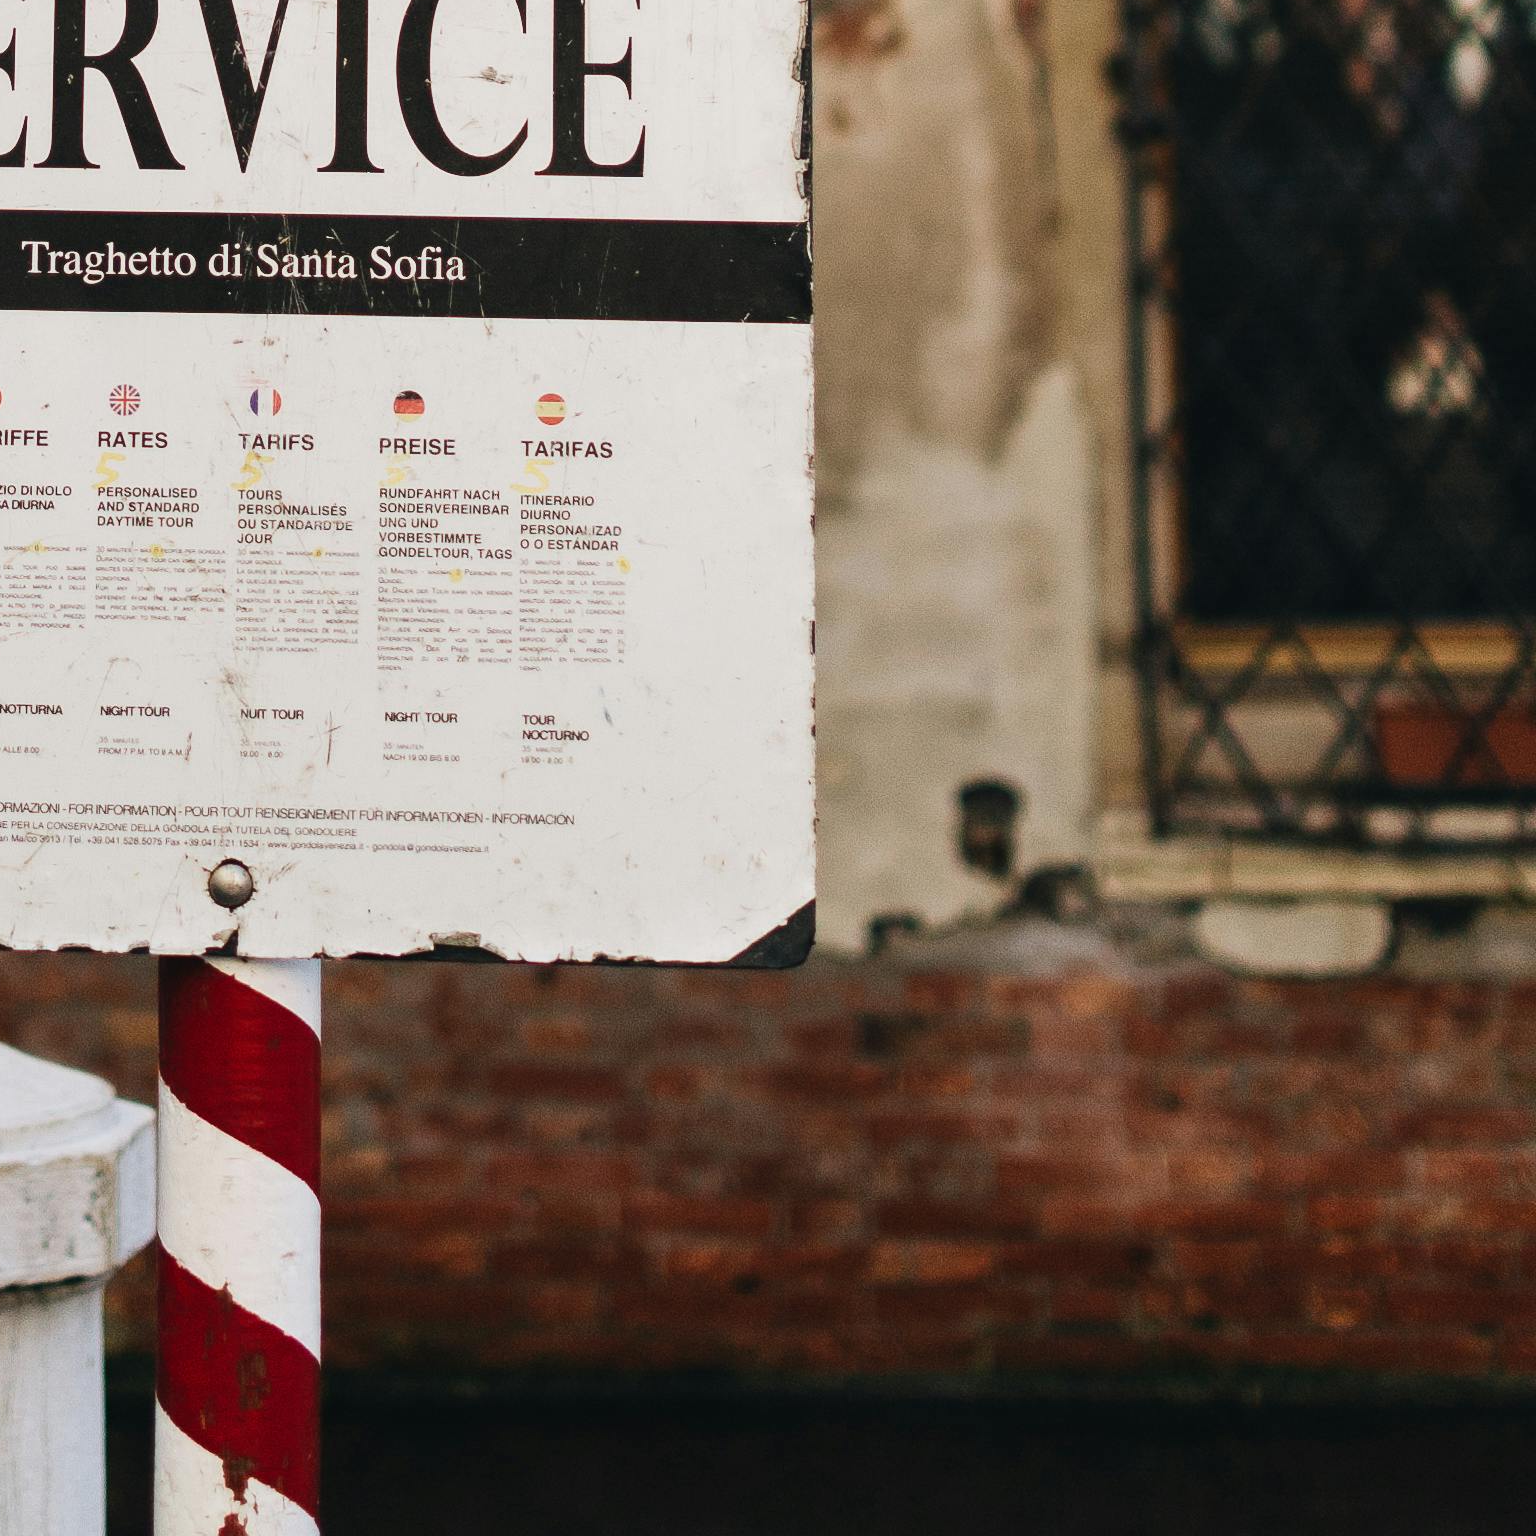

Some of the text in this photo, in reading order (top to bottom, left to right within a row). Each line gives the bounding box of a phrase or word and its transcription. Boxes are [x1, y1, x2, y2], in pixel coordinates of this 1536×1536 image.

[21, 240, 466, 282] Traghetto di Santa Sofia
[98, 431, 168, 449] RATES
[238, 433, 314, 451] TARIFS
[379, 437, 456, 456] PREISE
[521, 440, 613, 459] TARIFAS
[90, 451, 127, 491] 5
[229, 450, 275, 490] 5
[510, 459, 556, 494] 5
[20, 486, 32, 495] DI
[36, 486, 72, 496] NOLO
[97, 487, 198, 499] PERSONALISED
[237, 489, 283, 500] TOURS
[379, 488, 500, 500] RUNDFAHRT NACH
[12, 499, 55, 510] DIURNA
[520, 495, 595, 506] ITINERARIO
[97, 502, 200, 513] AND STANDARD
[379, 503, 509, 516] SONDERVEREINBAR
[520, 510, 571, 521] DIURNO
[97, 516, 194, 528] DAYTIME TOUR
[237, 519, 353, 531] OU STANDARD DE
[379, 518, 439, 529] UNG UND
[520, 525, 622, 536] PERSONALIZAD
[237, 533, 273, 544] JOUR
[379, 532, 482, 544] VORBESTIMMTE
[520, 536, 619, 550] O O ESTÁNDAR
[379, 547, 513, 560] GONDELTOUR, TAGS
[0, 704, 63, 715] NOTTURNA
[100, 706, 170, 717] NIGHT TOUR
[240, 709, 304, 720] NUIT TOUR
[384, 712, 458, 723] NIGHT TOUR
[522, 714, 555, 724] TOUR
[522, 730, 590, 741] NOCTURNO
[2, 745, 22, 753] ALLE
[68, 803, 94, 814] FOR
[95, 804, 176, 816] INFORMATION
[184, 806, 219, 816] POUR
[220, 807, 253, 817] TOUT
[255, 807, 356, 819] RENSEIGNEMENT
[386, 810, 483, 822] INFORMATIONEN
[11, 821, 31, 829] PER
[46, 822, 128, 831] CONSERVAZIONE
[130, 824, 161, 832] DELLA
[163, 824, 209, 833] GONDOLA
[236, 826, 272, 834] TUTELA
[295, 827, 357, 836] GONDOLIERE
[165, 838, 181, 846] Fax
